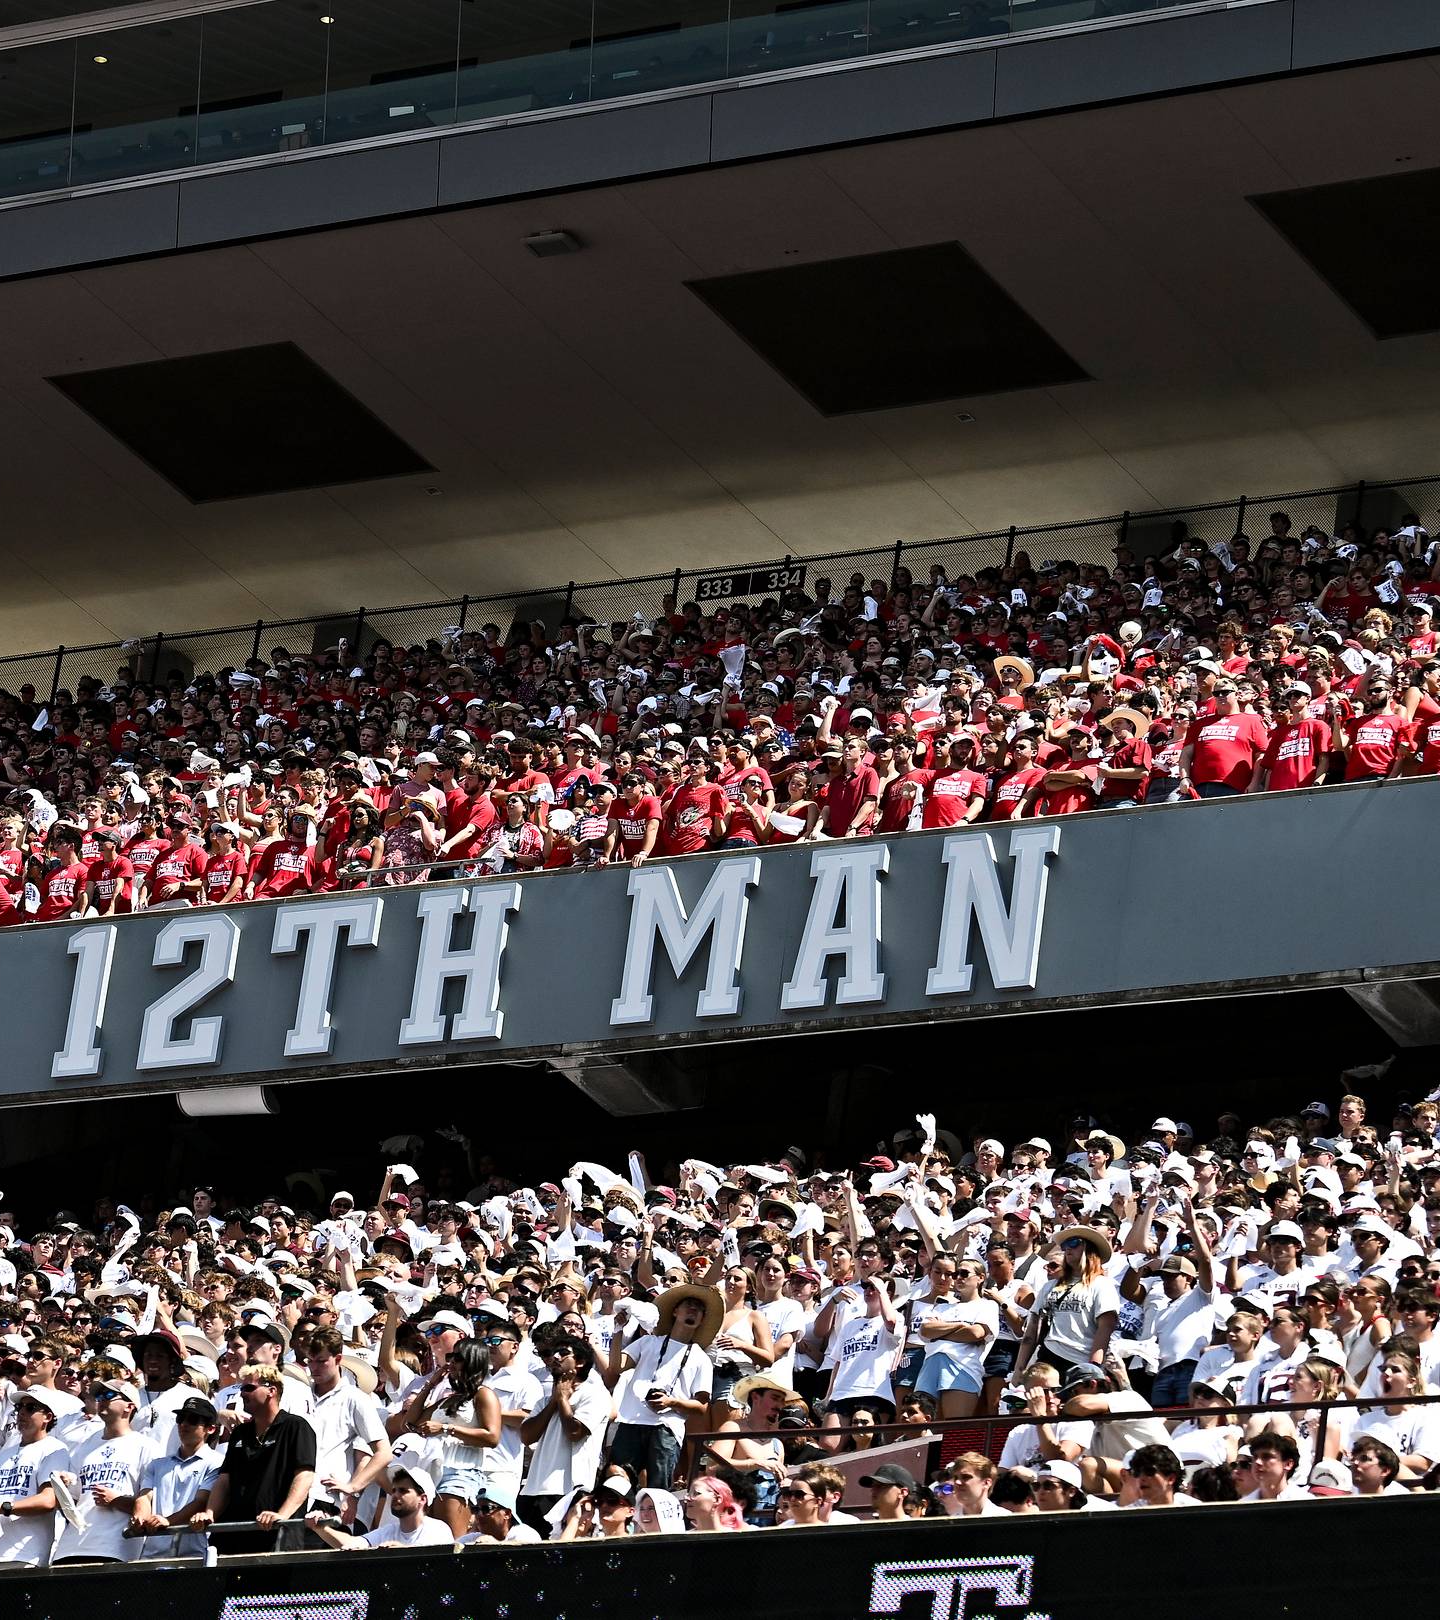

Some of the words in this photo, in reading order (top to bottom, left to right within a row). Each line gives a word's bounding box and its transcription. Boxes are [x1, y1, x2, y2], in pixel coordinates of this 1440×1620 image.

[700, 578, 733, 598] 333
[767, 569, 801, 590] 334
[50, 882, 523, 1080] 12TH
[610, 825, 1062, 1028] MAN
